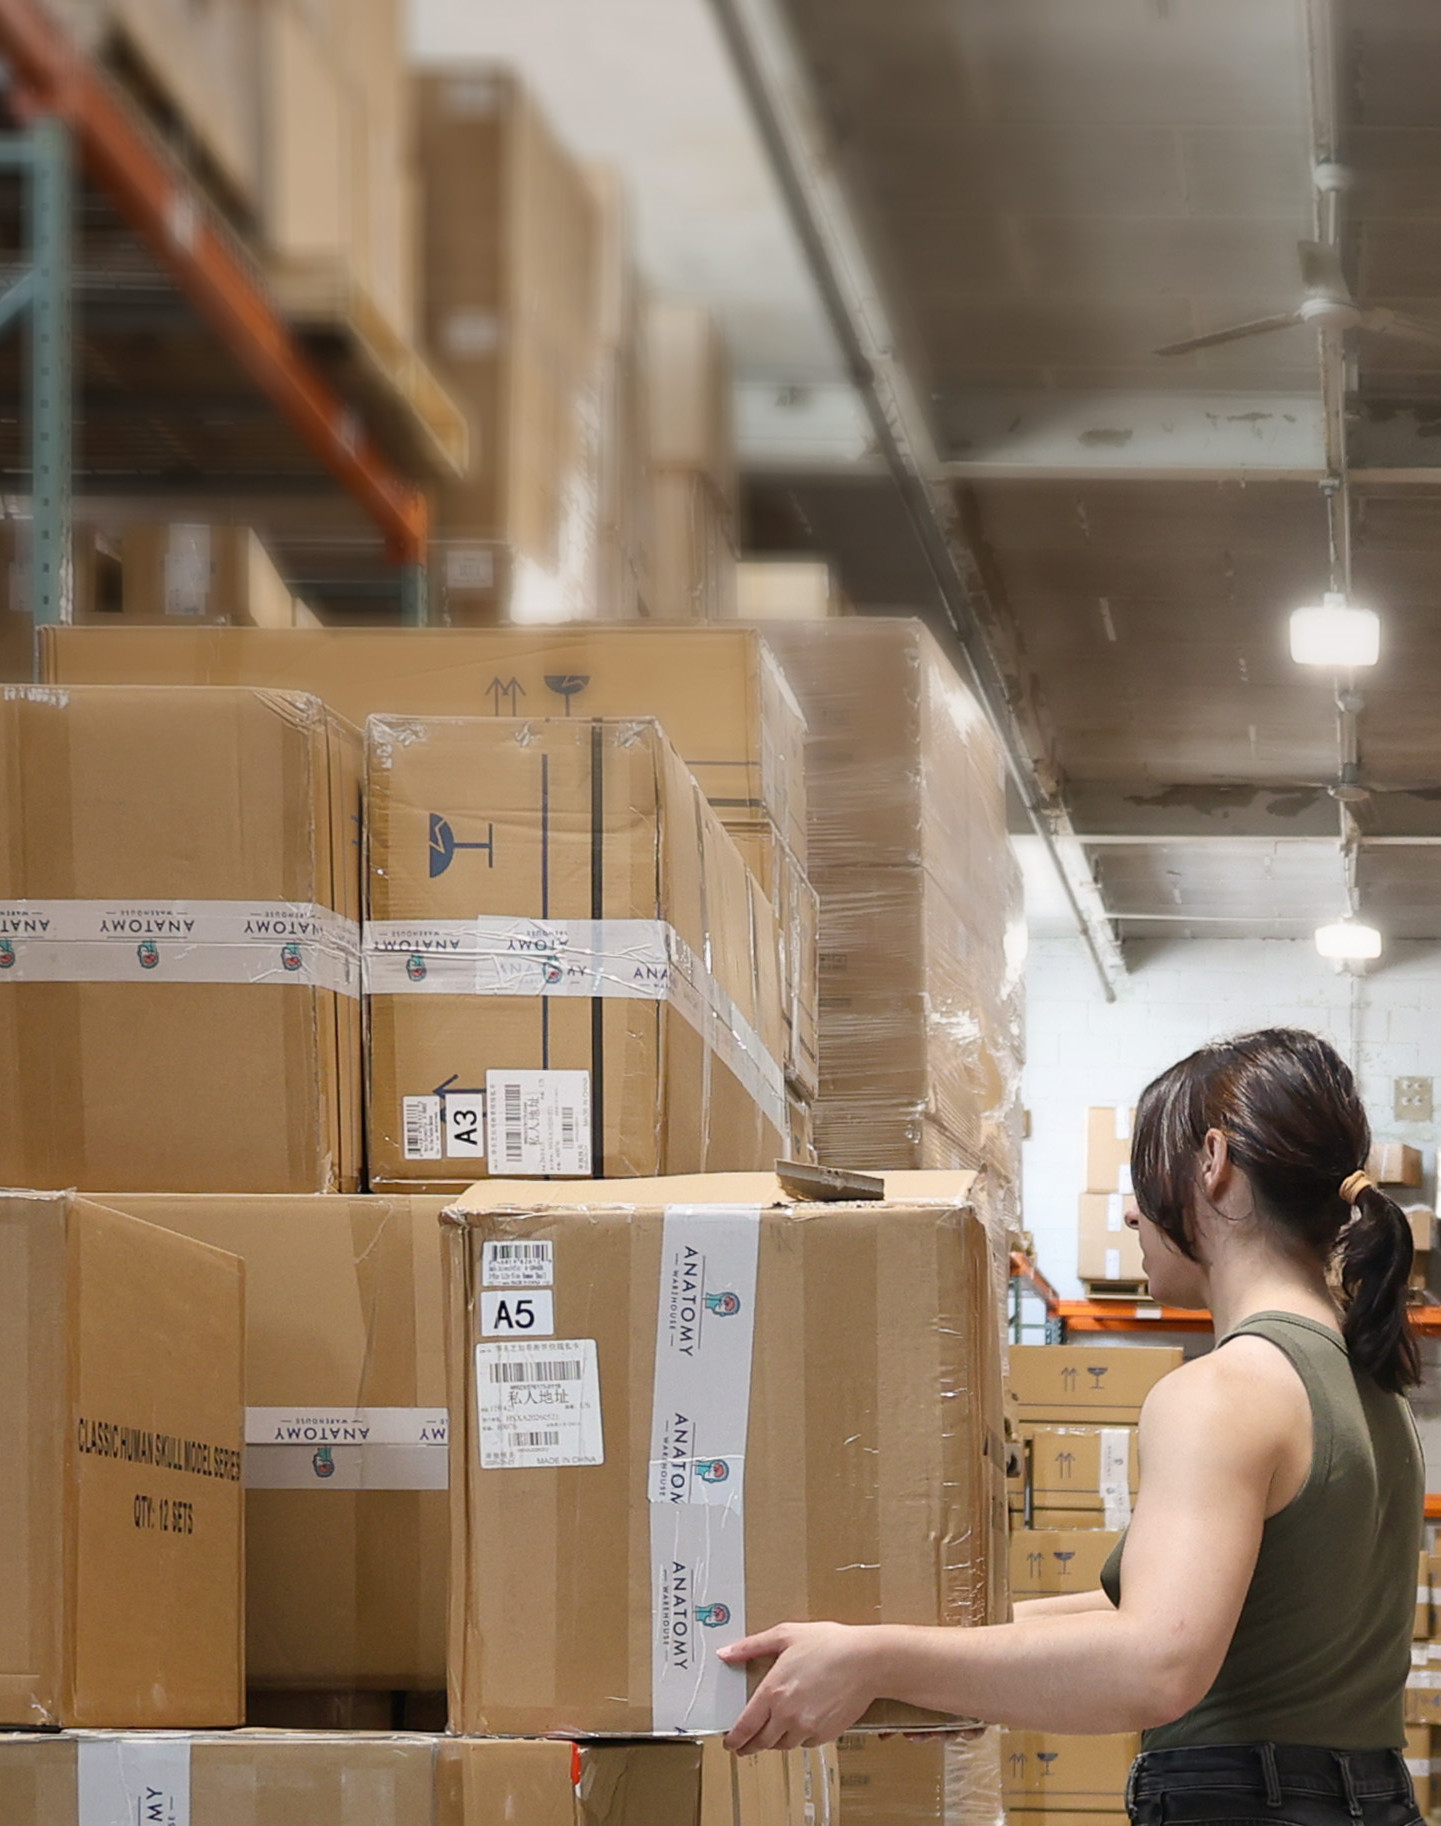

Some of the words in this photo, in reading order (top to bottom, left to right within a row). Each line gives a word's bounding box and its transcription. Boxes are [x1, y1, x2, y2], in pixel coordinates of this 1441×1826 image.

[100, 919, 194, 932] ANATOMY
[453, 1109, 477, 1146] A3
[494, 1300, 535, 1329] A5
[668, 1269, 678, 1331] WAREHOUSE
[679, 1245, 698, 1357] ANATOMY
[507, 1389, 569, 1406] 私人地址
[79, 1417, 119, 1458] CLASSIC
[275, 1428, 370, 1440] ANATOMY
[659, 1436, 669, 1497] WAREHOUSE
[160, 1498, 169, 1531] 12
[172, 1500, 193, 1534] SETS
[662, 1585, 670, 1646] WAREHOUSE
[672, 1560, 687, 1671] ANATOMY
